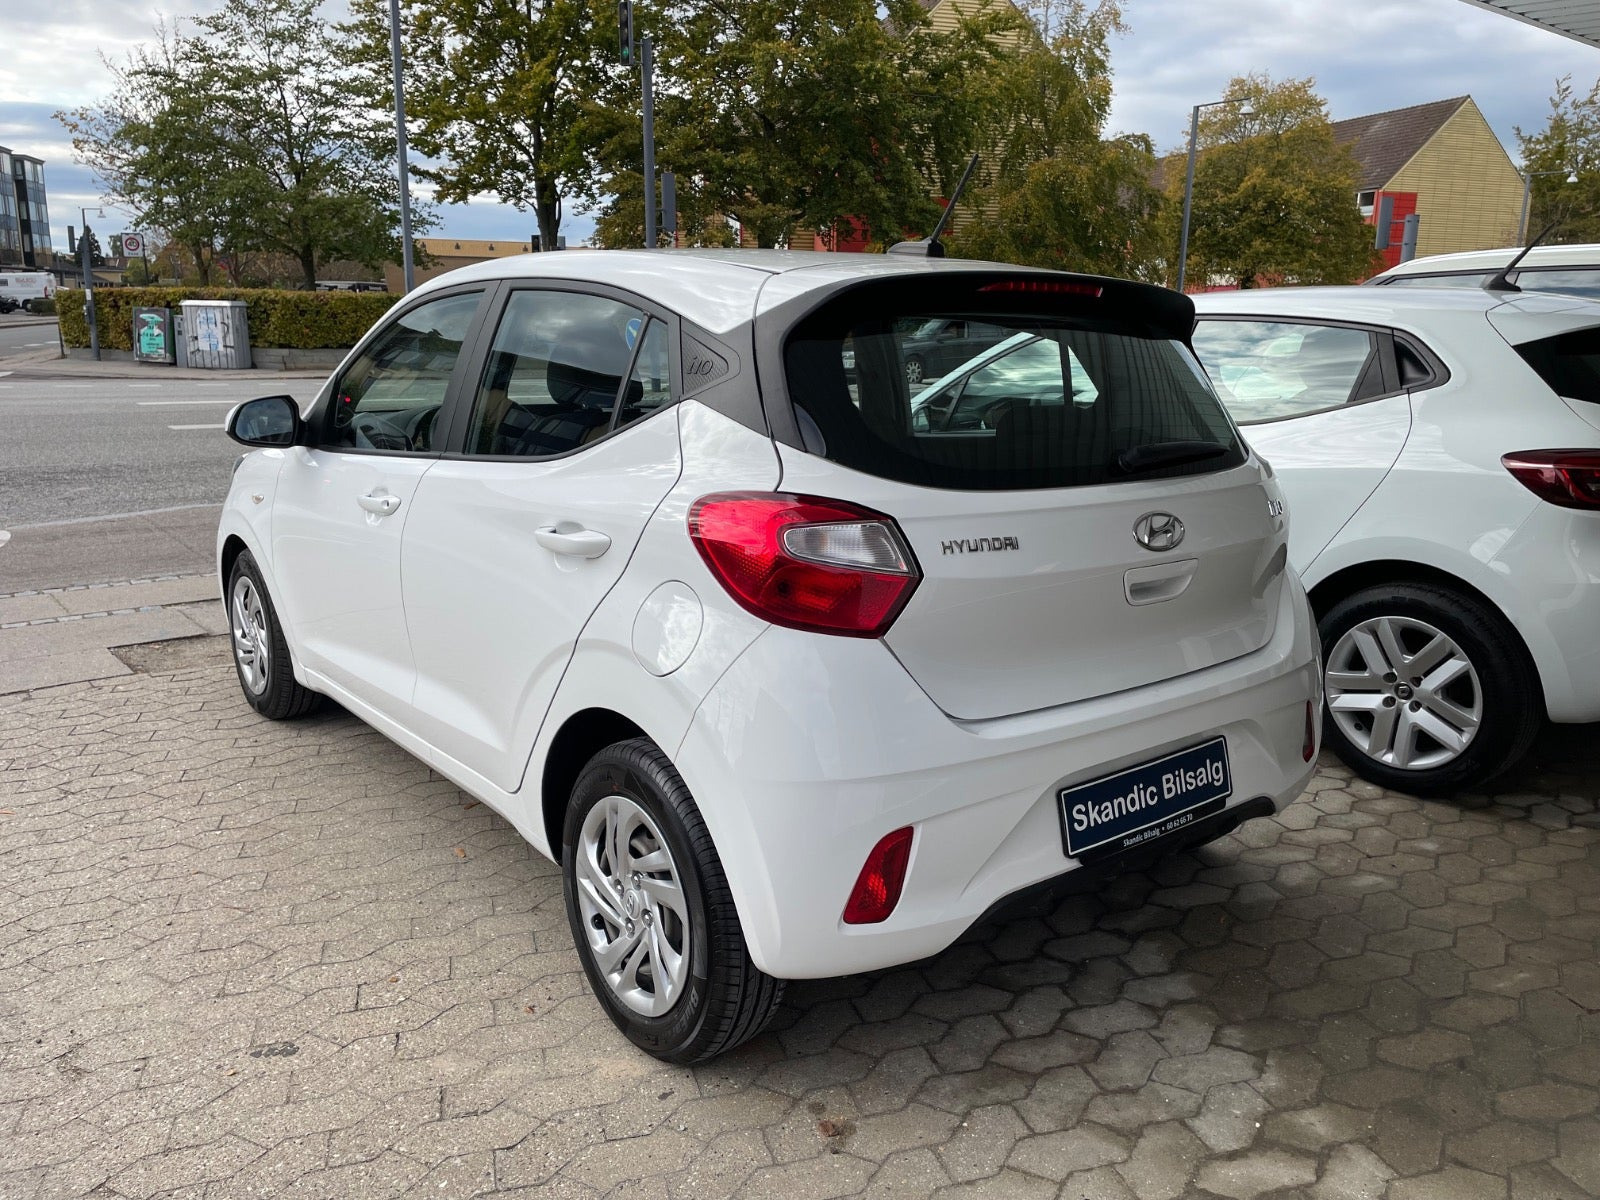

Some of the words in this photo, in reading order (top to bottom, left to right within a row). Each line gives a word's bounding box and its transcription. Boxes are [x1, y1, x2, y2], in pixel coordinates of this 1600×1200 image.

[941, 536, 1019, 555] HYUNDAI
[1072, 783, 1158, 831] Skandic
[1162, 759, 1224, 800] Bilsalg
[1123, 834, 1143, 847] Skandic
[1144, 828, 1160, 839] Bilsalg
